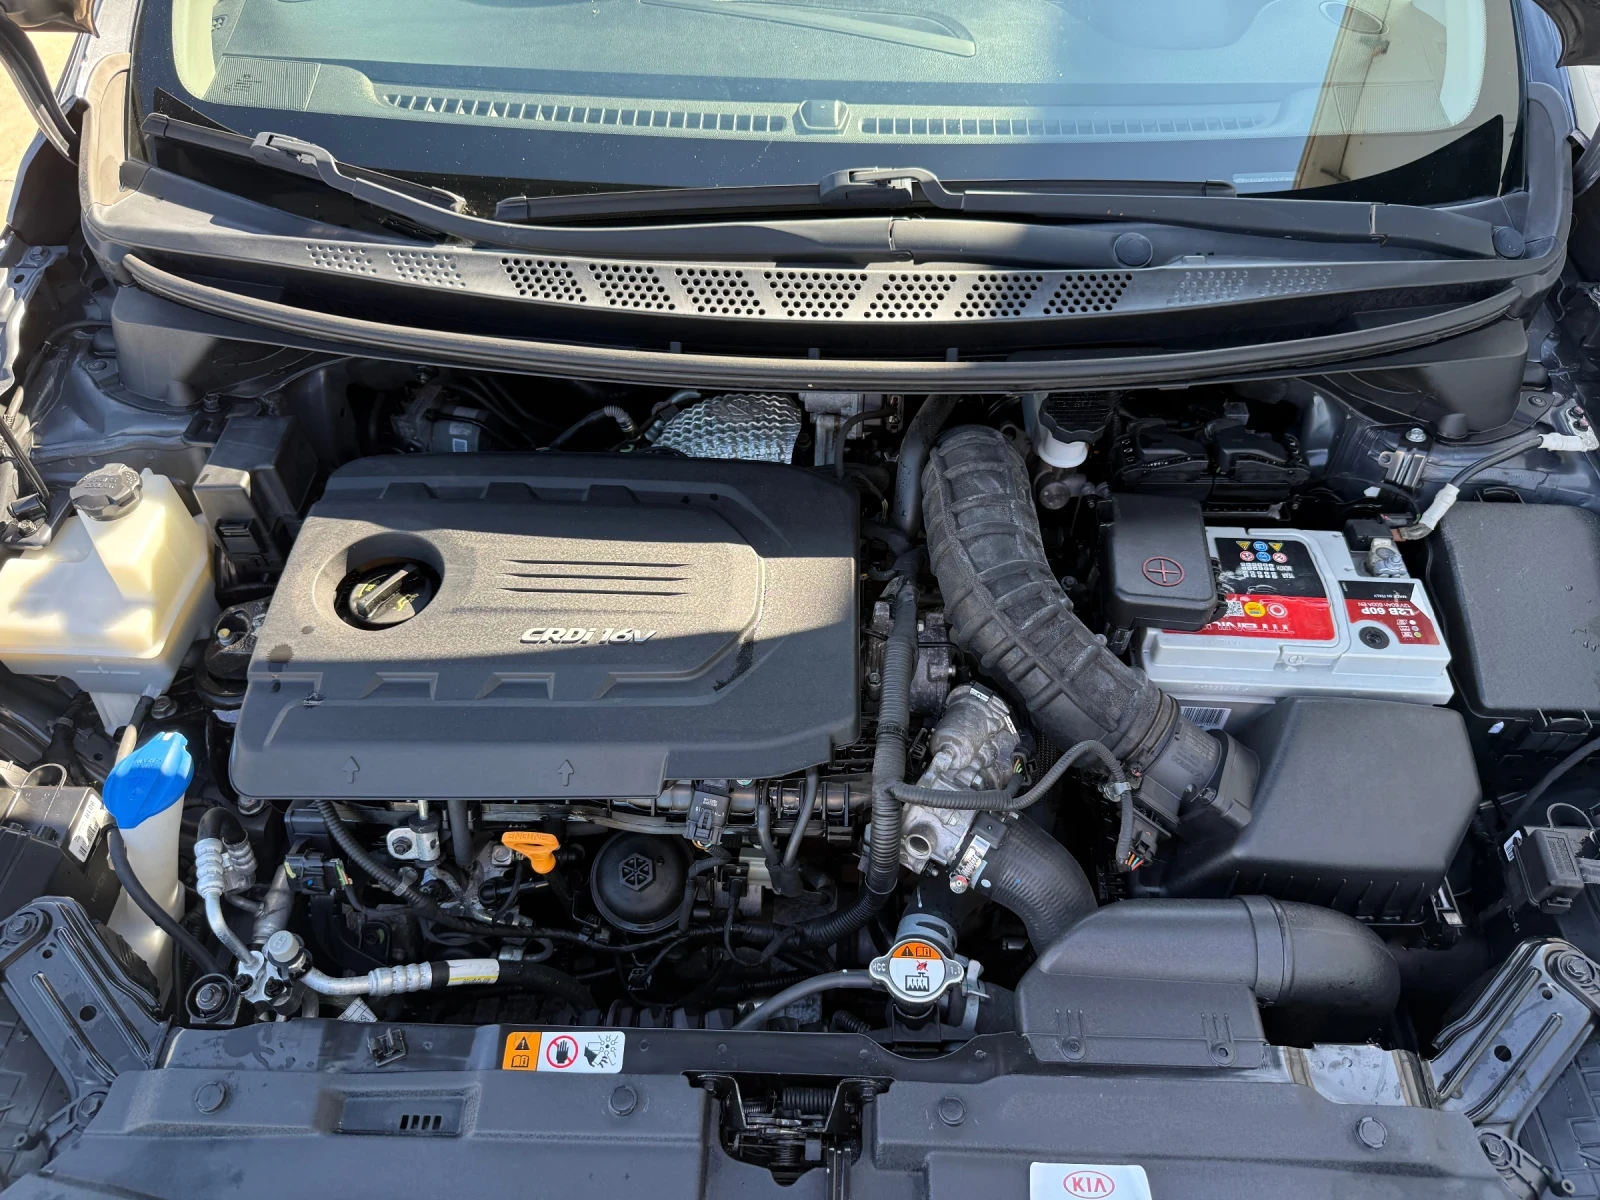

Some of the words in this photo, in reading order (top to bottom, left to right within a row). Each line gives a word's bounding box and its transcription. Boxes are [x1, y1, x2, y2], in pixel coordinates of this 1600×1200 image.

[1361, 607, 1386, 615] 60P
[1388, 607, 1415, 616] L2B
[520, 627, 597, 644] CRDi
[599, 628, 657, 644] 16V
[508, 833, 548, 841] ENGINE
[1072, 1177, 1107, 1192] KIA
